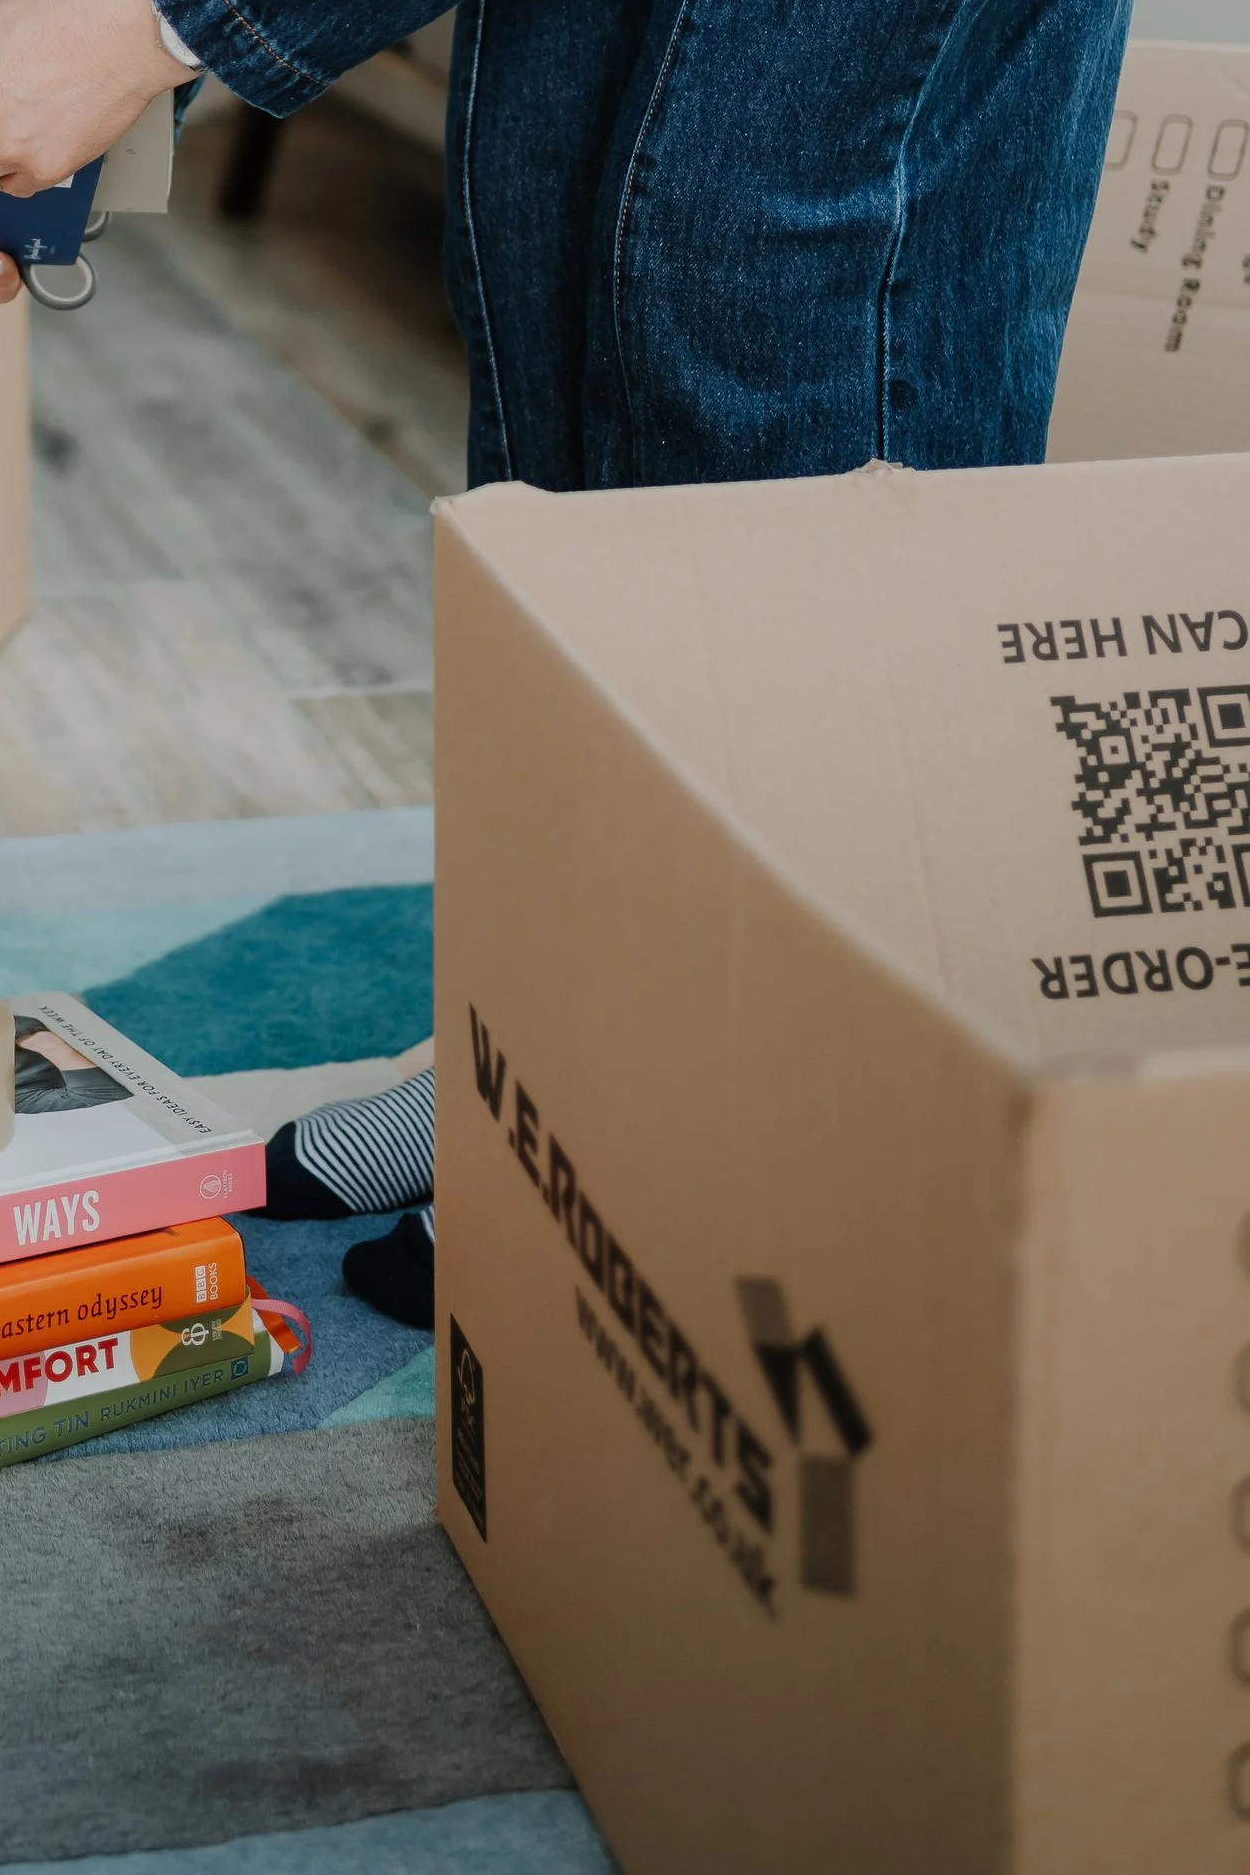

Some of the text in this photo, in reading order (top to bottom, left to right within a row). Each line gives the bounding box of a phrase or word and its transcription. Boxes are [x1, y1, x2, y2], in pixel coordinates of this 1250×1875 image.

[1130, 179, 1170, 255] Study
[1164, 184, 1226, 353] Dining Room
[997, 617, 1128, 664] HERE
[39, 1006, 212, 1134] EASY IDEAS FOR EVERY DAY OF THE WEEK
[13, 1189, 100, 1246] WAYS
[195, 1265, 207, 1304] BBC
[209, 1262, 218, 1301] BOOKS
[468, 999, 775, 1537] W.E.ROBERTS
[77, 1284, 163, 1324] odyssey
[54, 1410, 90, 1439] TIN
[100, 1384, 178, 1422] RUKMINI
[184, 1368, 223, 1395] IYER
